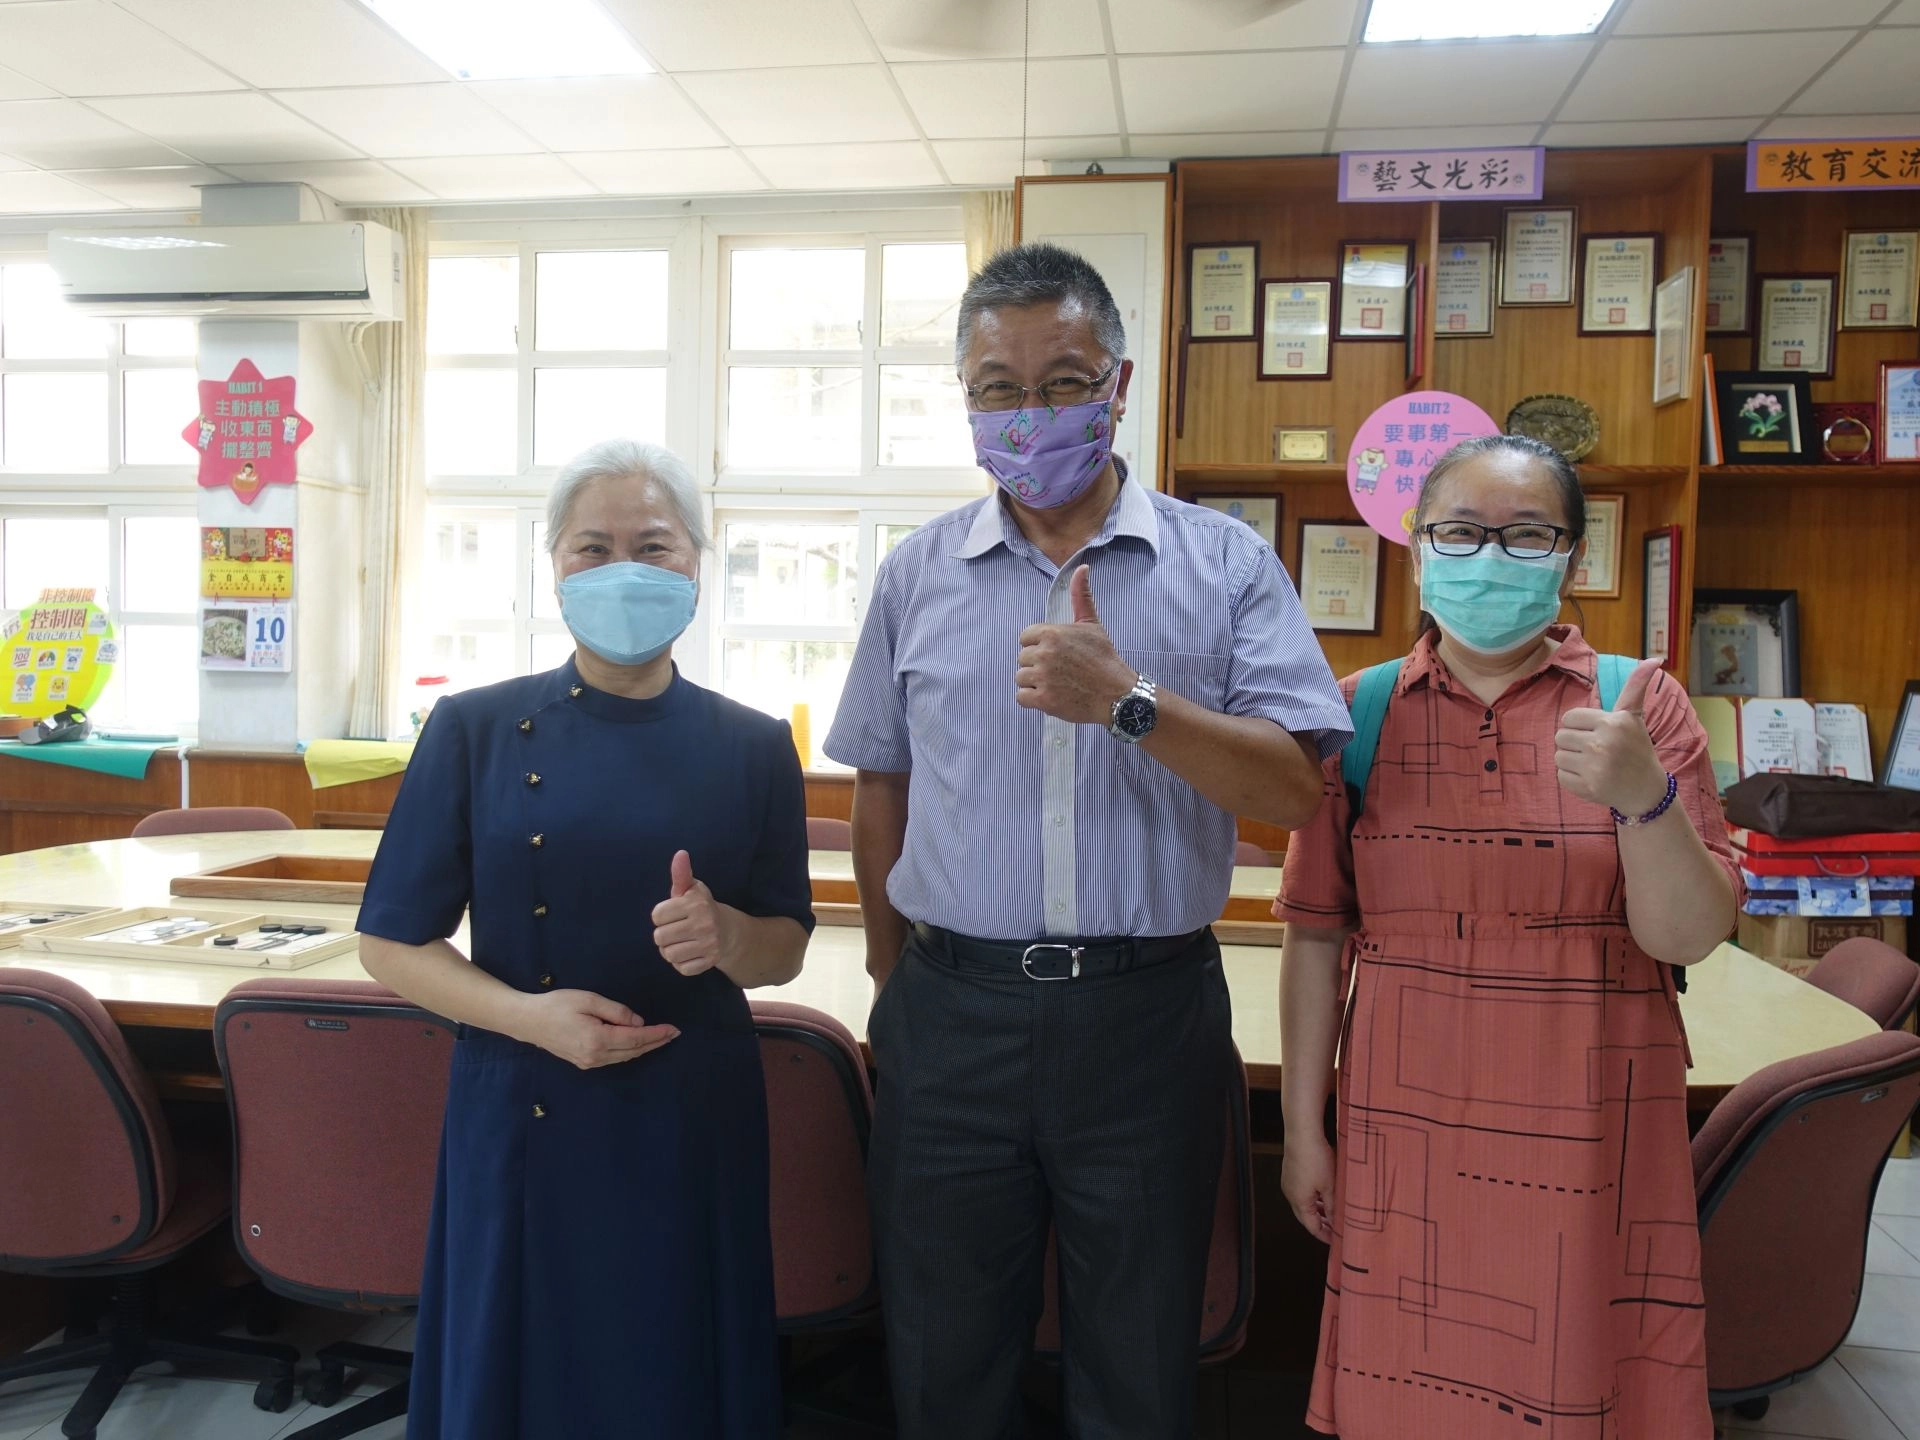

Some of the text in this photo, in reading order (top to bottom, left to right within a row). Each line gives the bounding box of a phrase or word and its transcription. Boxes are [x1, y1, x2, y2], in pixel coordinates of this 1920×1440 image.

[1780, 147, 1920, 182] 教育交流
[1373, 158, 1509, 192] 藝文光彩
[228, 382, 256, 394] HABIT
[215, 399, 280, 417] 主動積極
[1408, 402, 1451, 414] HABIT 2
[221, 419, 272, 437] 收東西
[1384, 424, 1473, 443] 要事第一
[222, 440, 272, 459] 擺整齊
[31, 608, 87, 629] 控制圈
[26, 631, 83, 641] 我是自己的主人
[255, 616, 285, 643] 10
